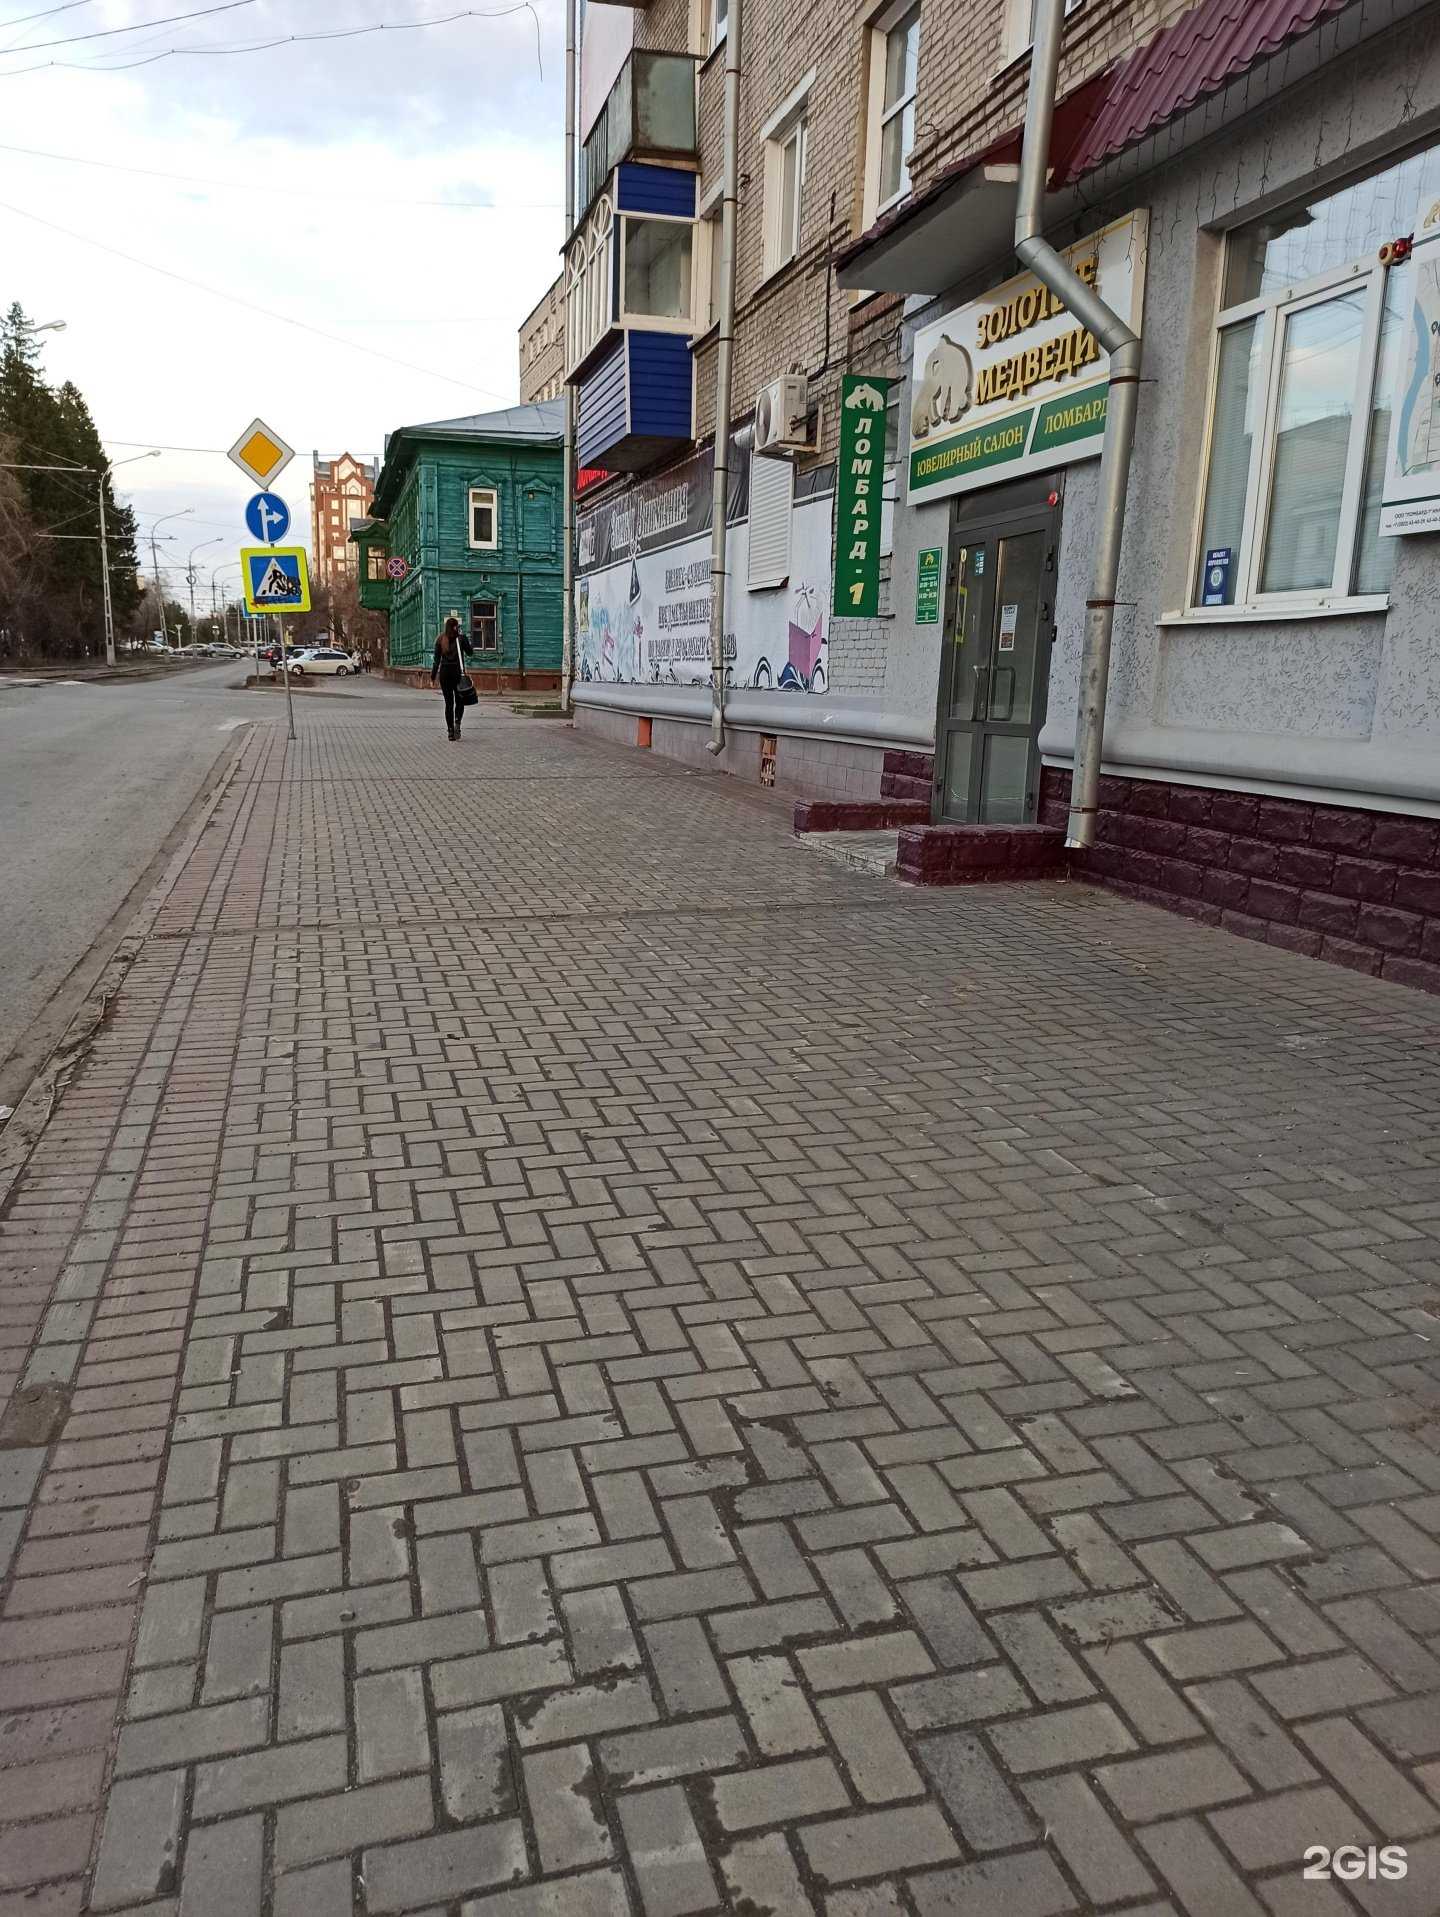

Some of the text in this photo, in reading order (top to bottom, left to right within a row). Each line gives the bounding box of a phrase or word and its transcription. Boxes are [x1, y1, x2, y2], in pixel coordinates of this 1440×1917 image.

[975, 326, 1096, 405] МЕДВЕДИ
[916, 425, 1024, 477] ЮВЕЛИРНЫЙ САЛОН
